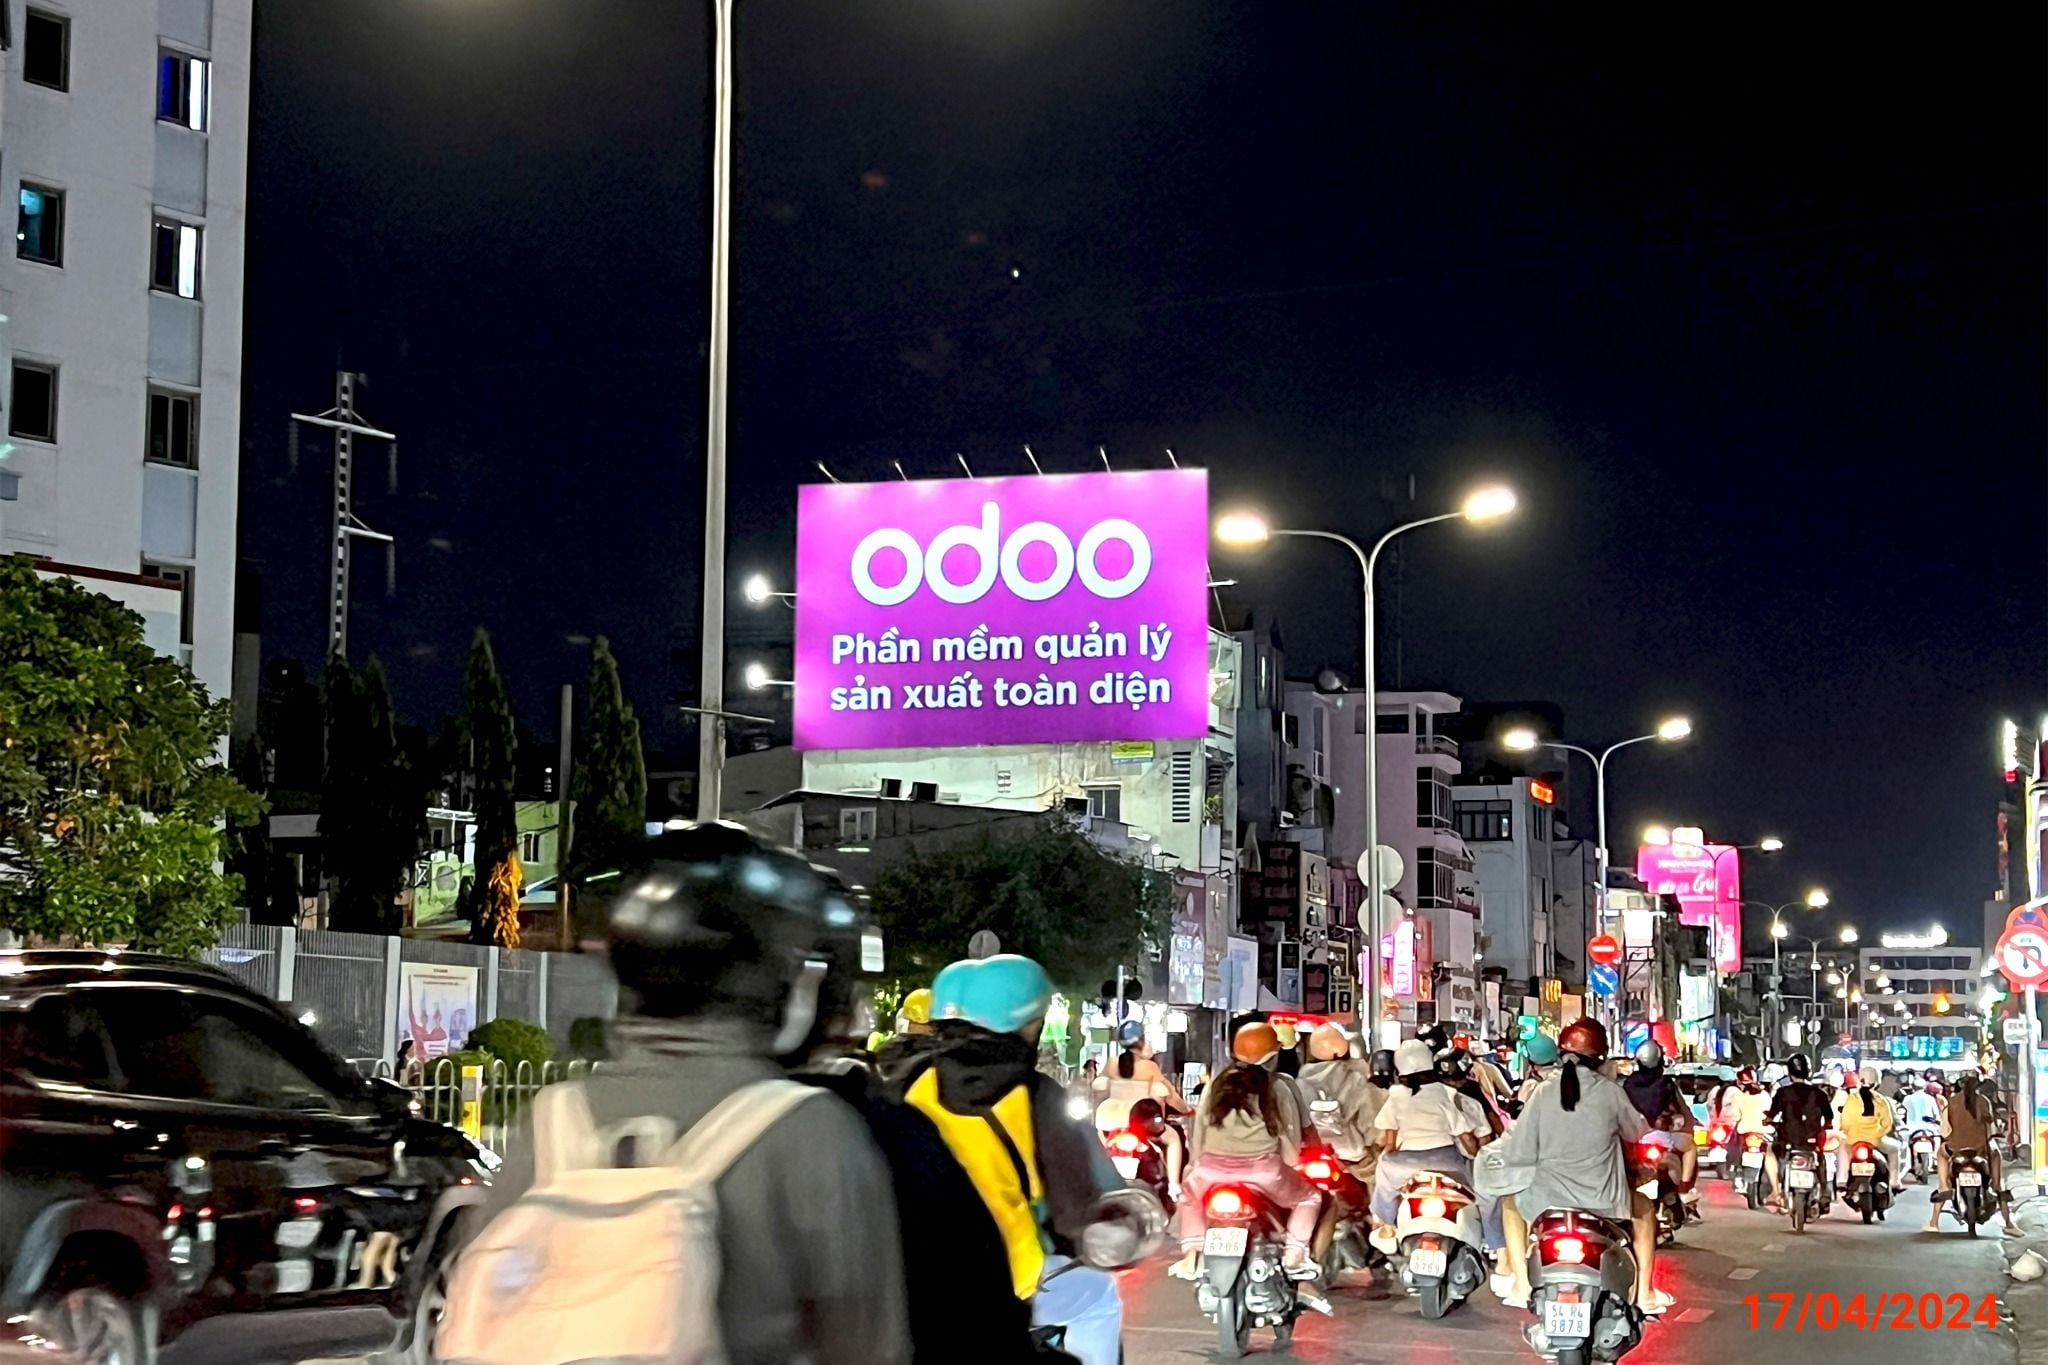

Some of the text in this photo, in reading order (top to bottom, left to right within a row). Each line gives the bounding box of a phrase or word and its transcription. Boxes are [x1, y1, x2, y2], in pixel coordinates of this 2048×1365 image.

[851, 500, 1152, 606] odoo
[832, 620, 1172, 665] Phần mềm quản lý
[830, 670, 1170, 711] sản xuất toàn diện
